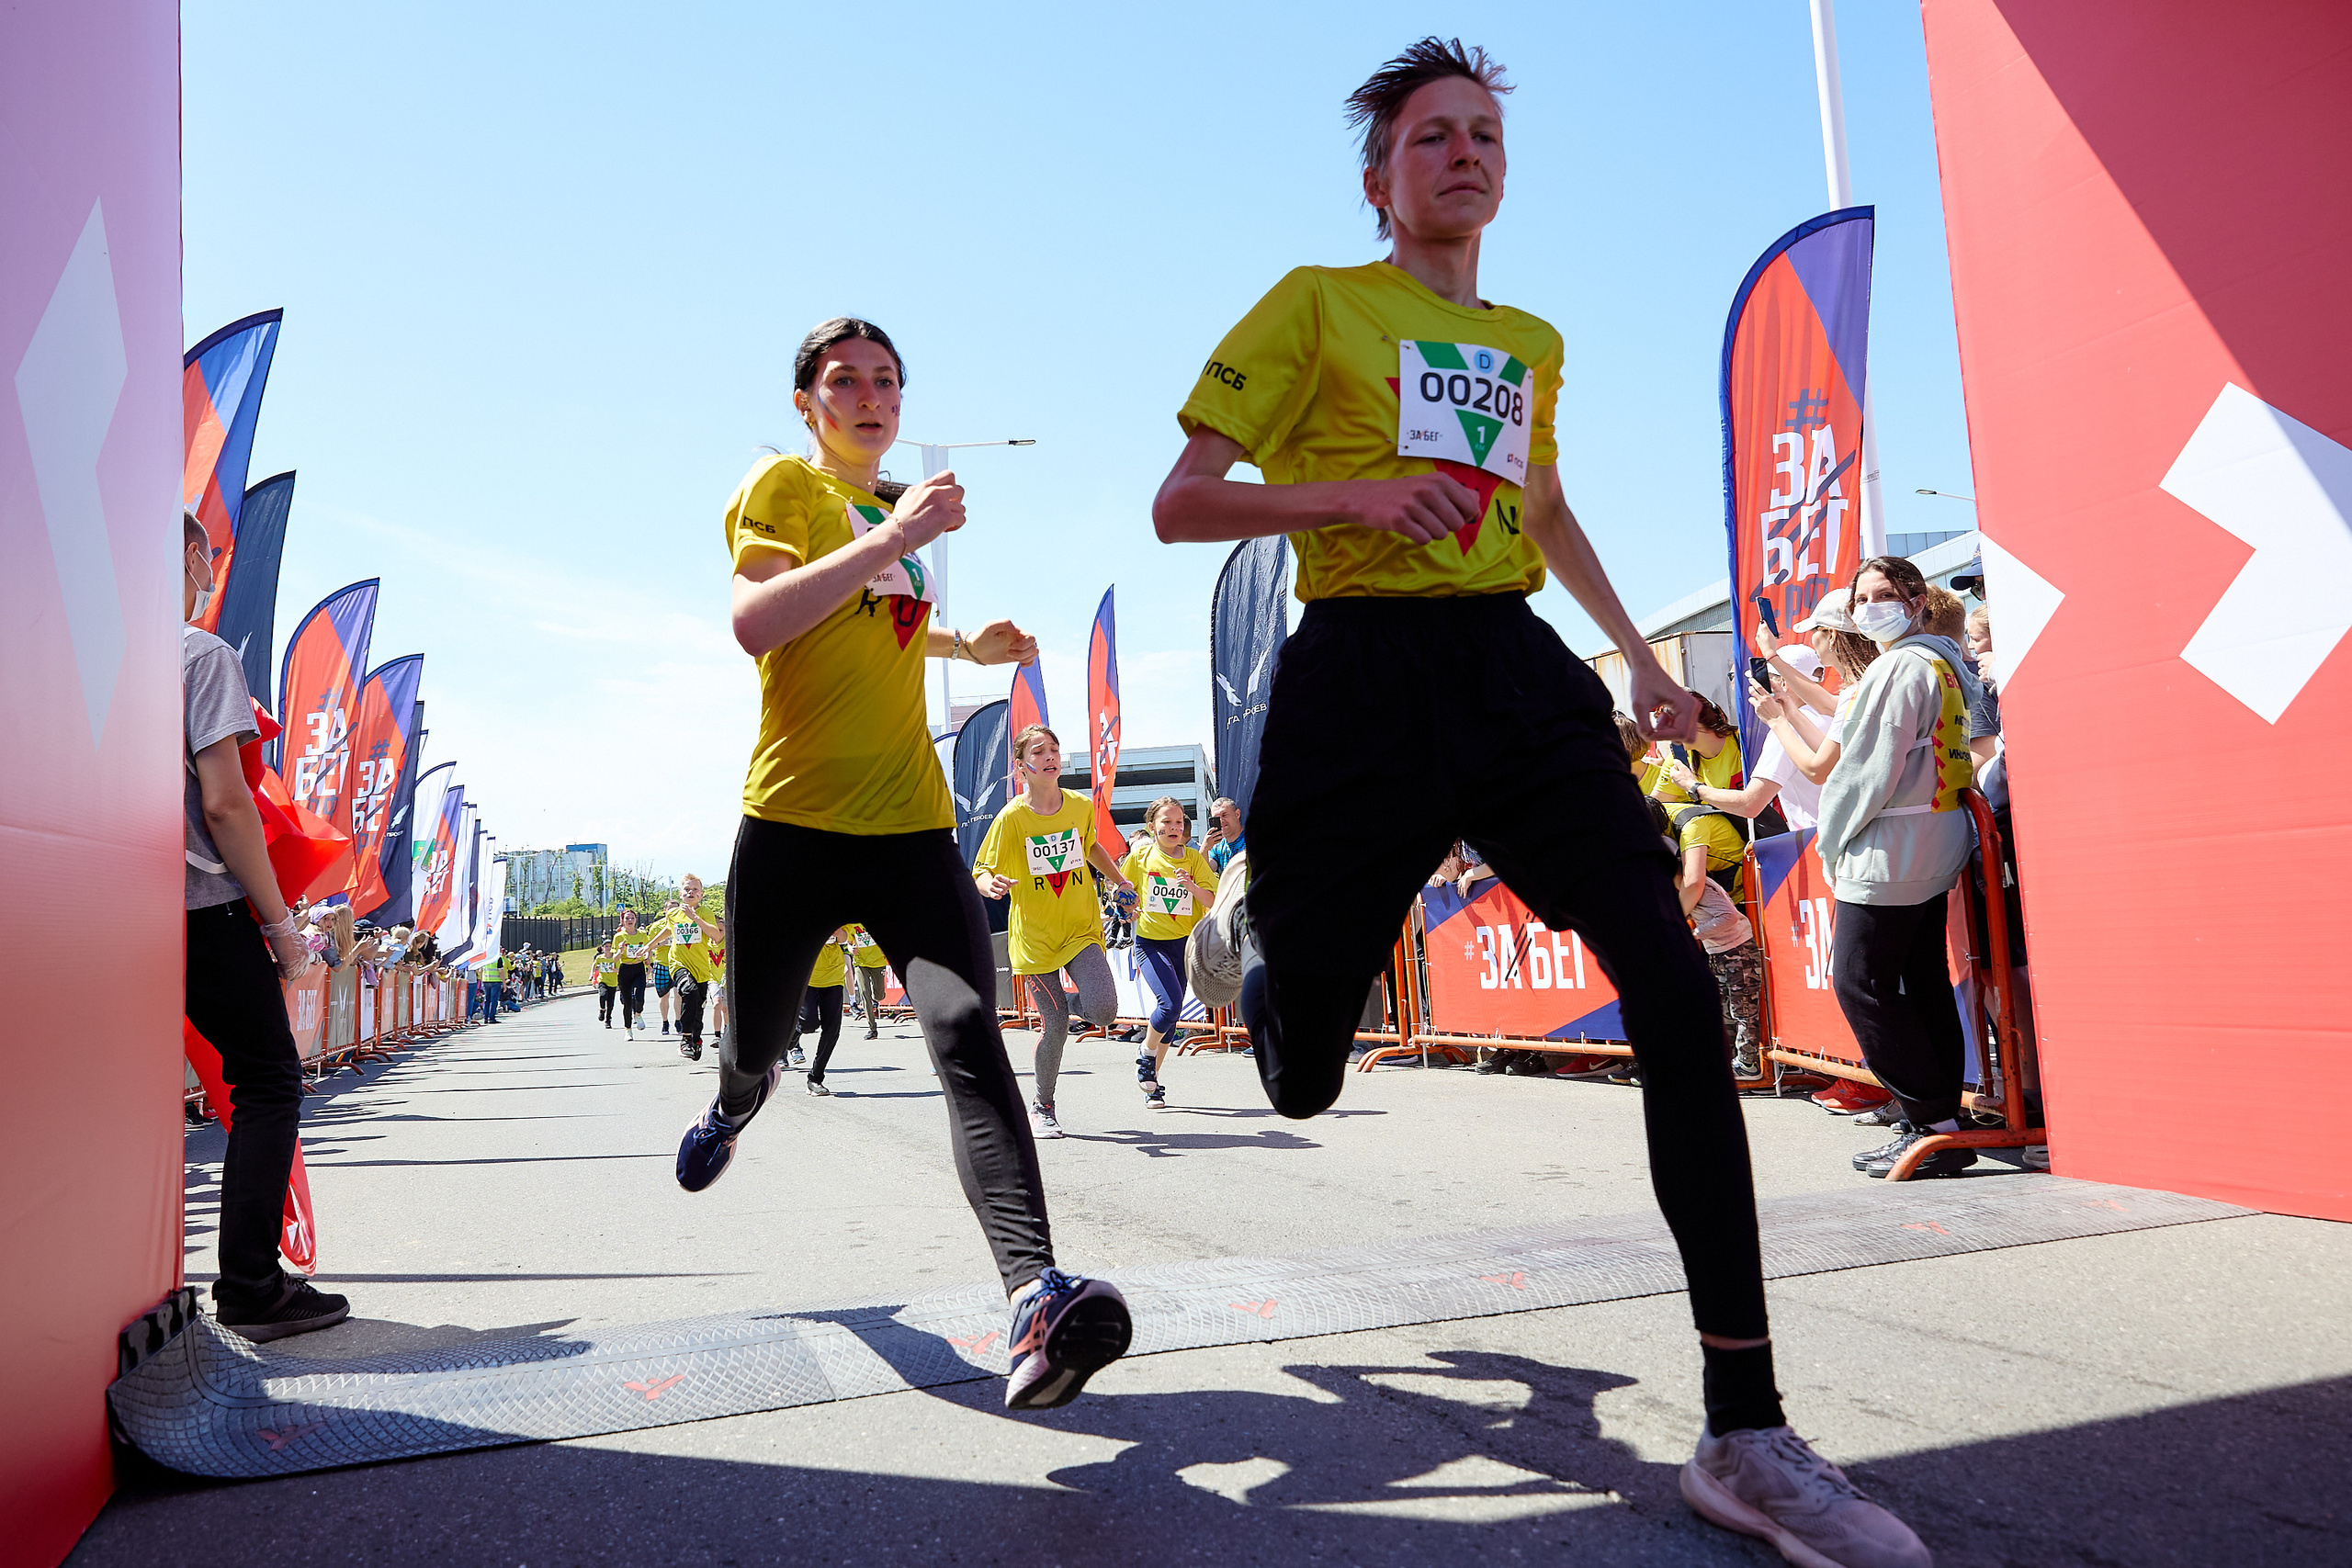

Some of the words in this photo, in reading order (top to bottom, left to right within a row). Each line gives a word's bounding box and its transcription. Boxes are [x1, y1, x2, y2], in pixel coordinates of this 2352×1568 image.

[1206, 361, 1247, 391] ПСБ
[1479, 354, 1491, 369] D
[1420, 372, 1522, 426] 00208
[1477, 426, 1486, 444] 1
[1770, 423, 1842, 509] ЗА
[742, 515, 775, 534] ПСБ
[1760, 499, 1849, 588] БЕГ
[305, 707, 349, 756] ЗА
[357, 757, 395, 798] ЗА
[352, 792, 394, 835] БЕ
[1033, 839, 1075, 859] 00137
[1034, 869, 1083, 891] RUN
[1153, 886, 1188, 898] 00409
